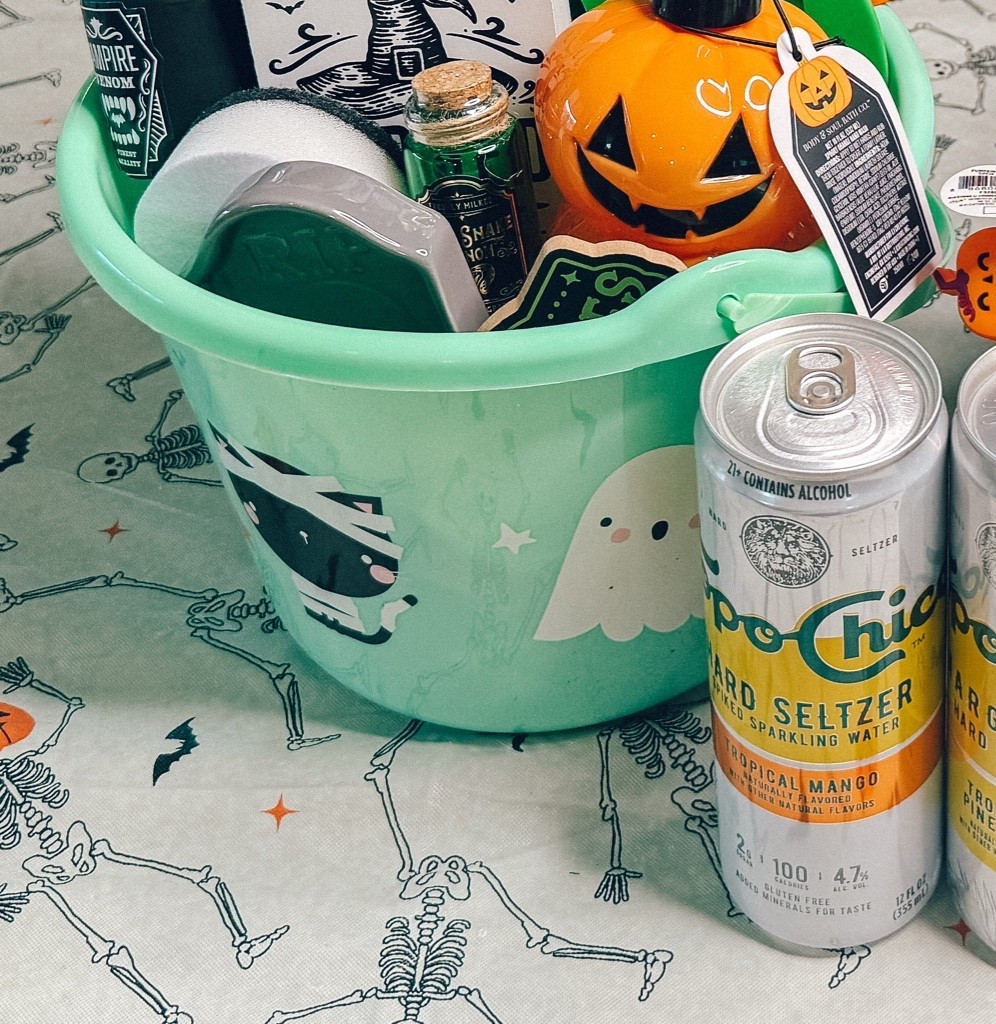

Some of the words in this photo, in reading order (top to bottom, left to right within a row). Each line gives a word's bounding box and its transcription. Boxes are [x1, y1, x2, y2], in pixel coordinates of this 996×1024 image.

[89, 43, 139, 72] AMPIRE
[802, 134, 821, 152] BODY
[824, 119, 843, 136] SOUL
[840, 108, 859, 124] BATH
[463, 196, 494, 209] MILKE
[727, 460, 742, 478] 21+
[744, 470, 795, 499] CONTAINS
[798, 483, 852, 500] ALCOHOL
[852, 534, 898, 557] SELTZER
[797, 583, 940, 683] Chic
[712, 675, 744, 721] SPIKED
[750, 717, 838, 747] SPARKLING
[848, 717, 900, 744] WATER
[773, 678, 913, 730] SELTZER
[953, 701, 988, 750] HARD
[724, 736, 799, 791] TROPICAL
[809, 771, 879, 793] MANGO
[743, 771, 793, 800] NATURALLY
[798, 792, 851, 804] FLAVORED
[748, 785, 775, 804] OTHER
[778, 800, 824, 814] NATURAL
[829, 799, 875, 814] FLAVORS
[773, 858, 808, 883] 100
[833, 865, 869, 884] 4.7%
[735, 869, 759, 895] ADDED
[763, 891, 811, 914] MINERALS
[816, 907, 835, 916] FOR
[840, 902, 872, 915] TASTE
[764, 882, 801, 903] GLUTEN
[805, 897, 831, 906] FREE
[895, 892, 905, 907] 12
[905, 885, 917, 899] FL
[916, 873, 927, 891] OZ
[892, 900, 913, 920] (355
